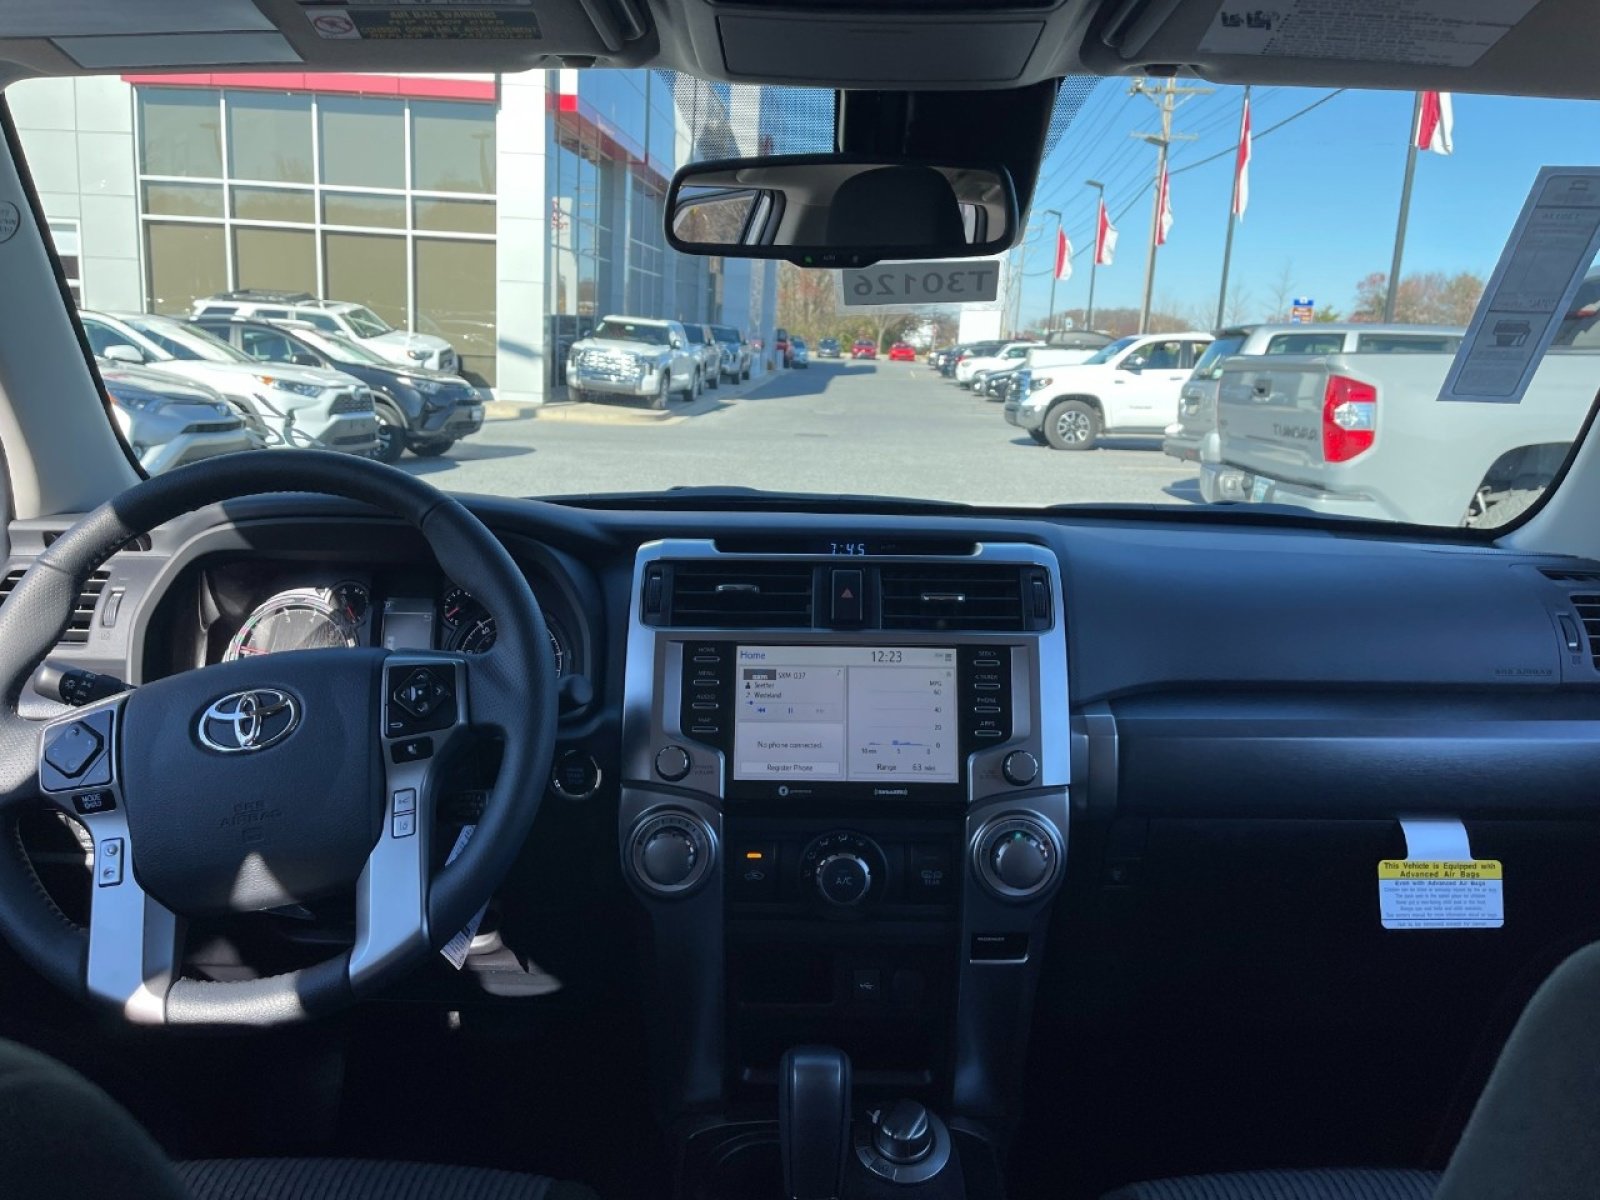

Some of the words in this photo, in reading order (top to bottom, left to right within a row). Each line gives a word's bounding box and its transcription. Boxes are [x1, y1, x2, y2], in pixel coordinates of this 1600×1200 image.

[1272, 422, 1318, 440] TUNDRA
[740, 651, 766, 660] Home
[872, 650, 903, 663] 12:23
[768, 741, 788, 750] phone
[767, 764, 792, 772] Register
[877, 763, 897, 771] Range
[1443, 863, 1477, 871] Equipped
[835, 876, 852, 886] A/C
